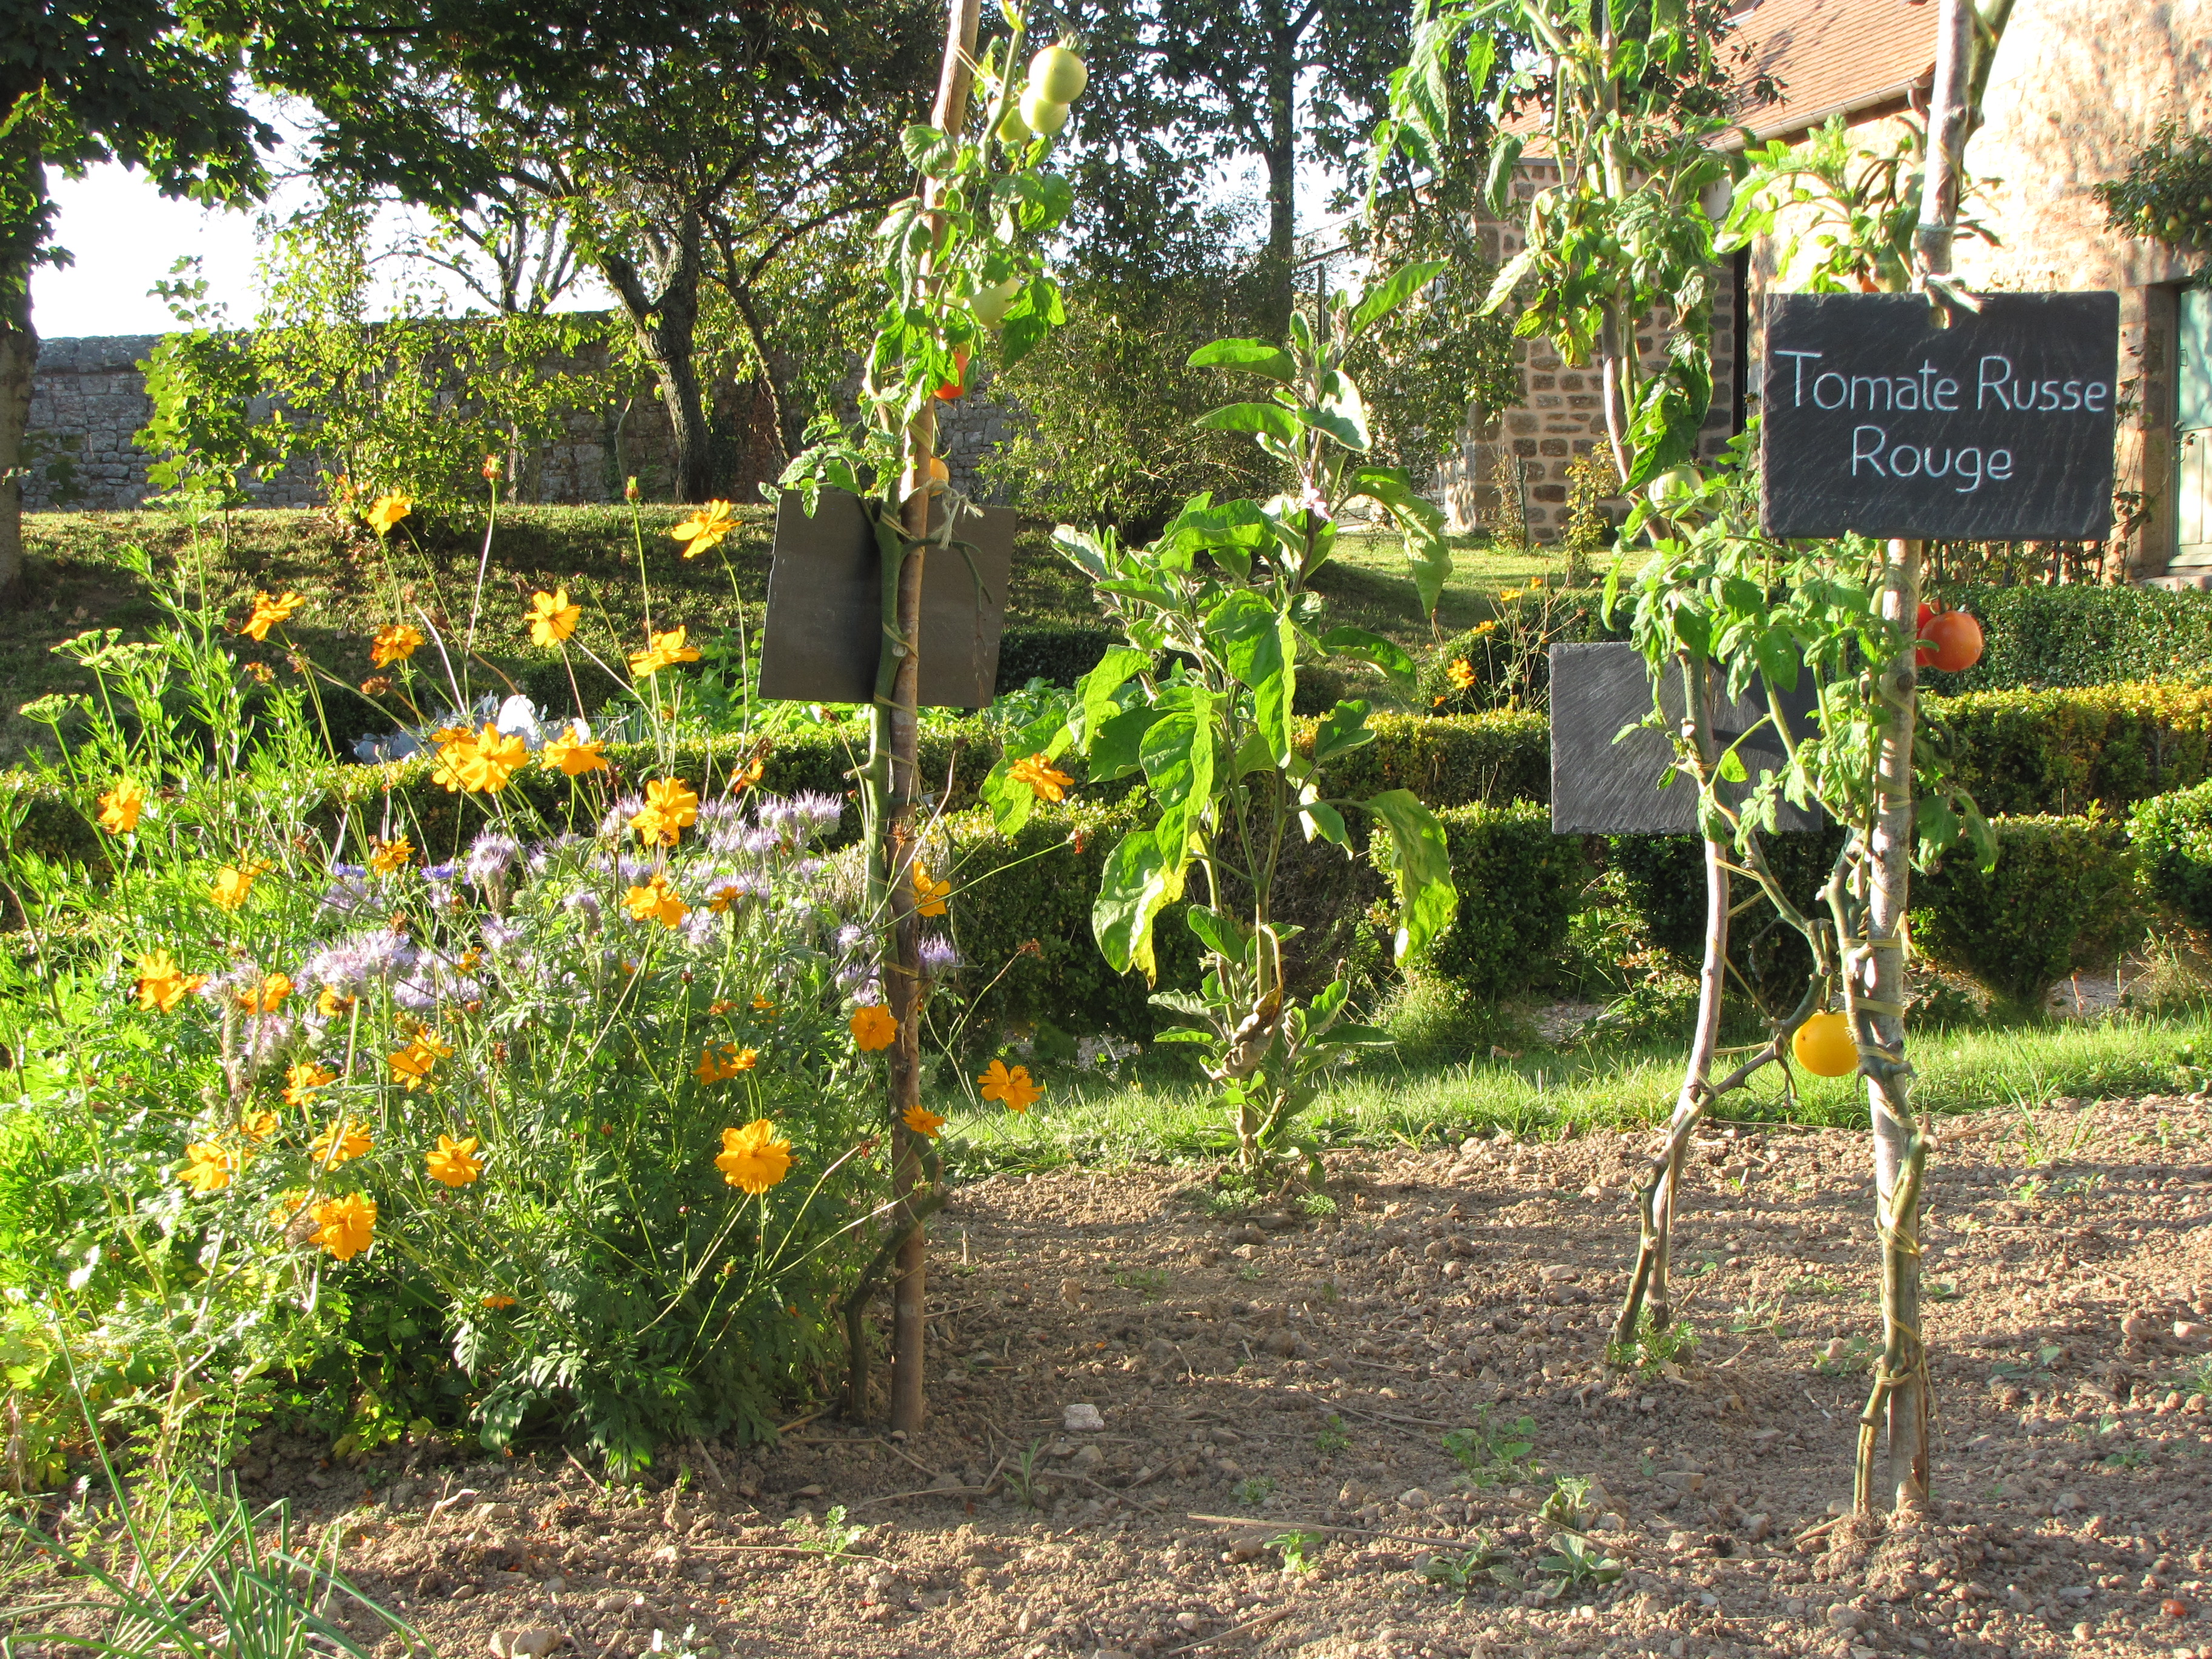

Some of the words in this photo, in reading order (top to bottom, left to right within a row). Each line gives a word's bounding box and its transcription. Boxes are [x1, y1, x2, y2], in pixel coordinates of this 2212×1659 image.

[1774, 350, 1959, 411] Tomate
[1977, 355, 2107, 412] Russe
[1851, 425, 2013, 493] Rouge
